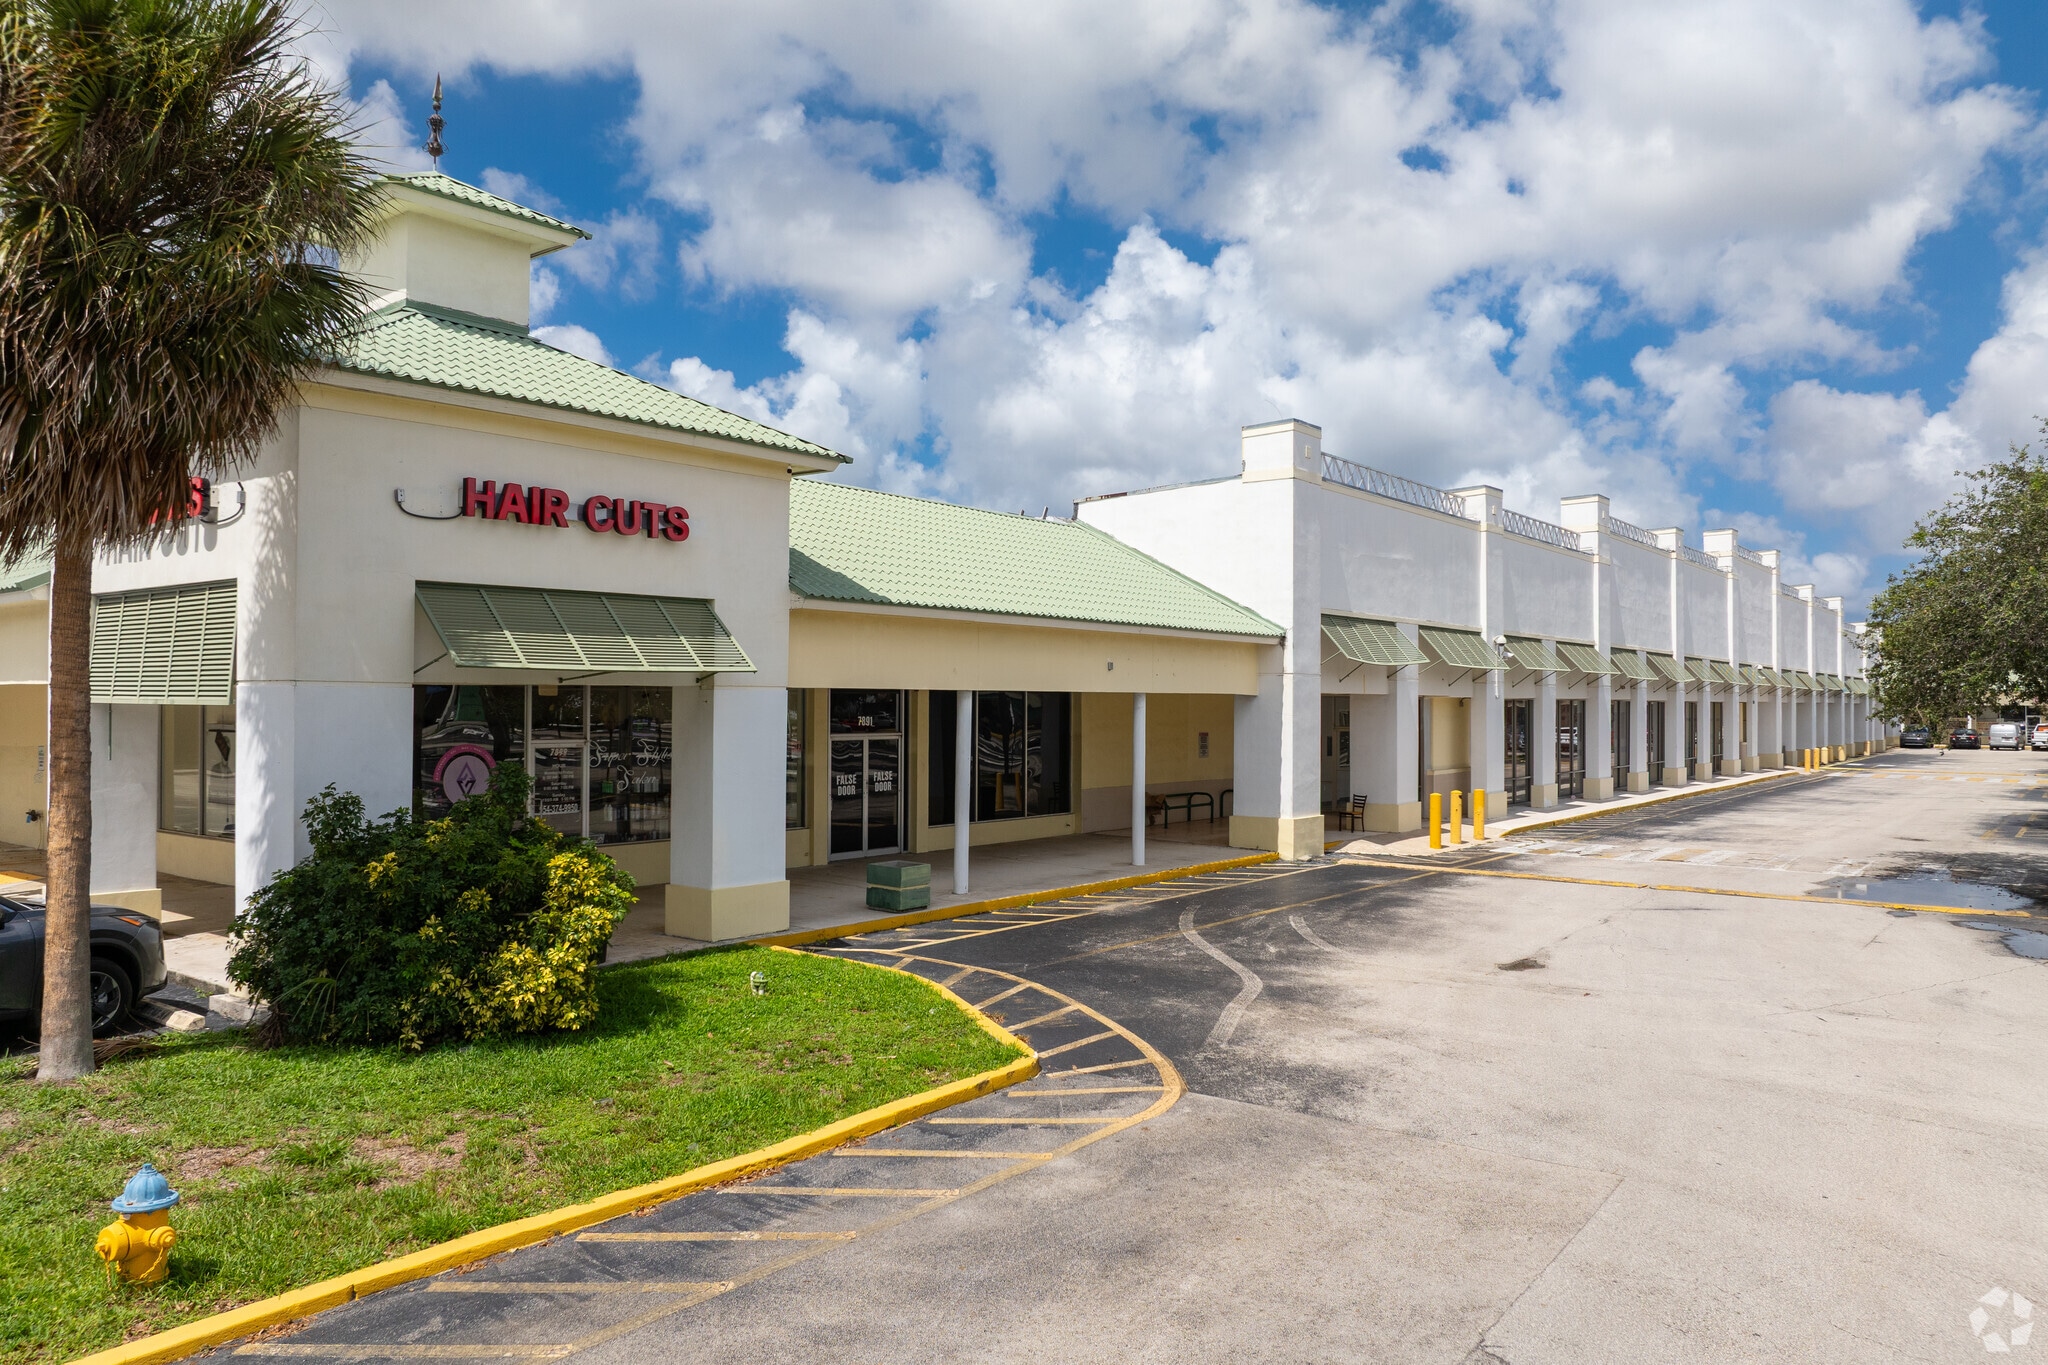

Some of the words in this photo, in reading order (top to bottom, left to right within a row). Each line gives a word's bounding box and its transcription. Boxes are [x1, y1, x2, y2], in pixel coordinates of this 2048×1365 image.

[462, 477, 569, 528] HAIR
[584, 495, 690, 542] CUTS
[858, 716, 874, 727] 7891
[617, 765, 657, 791] Salon
[836, 774, 857, 785] FALSE
[873, 771, 893, 782] FALSE
[838, 785, 856, 796] DOOR
[875, 781, 892, 792] DOOR
